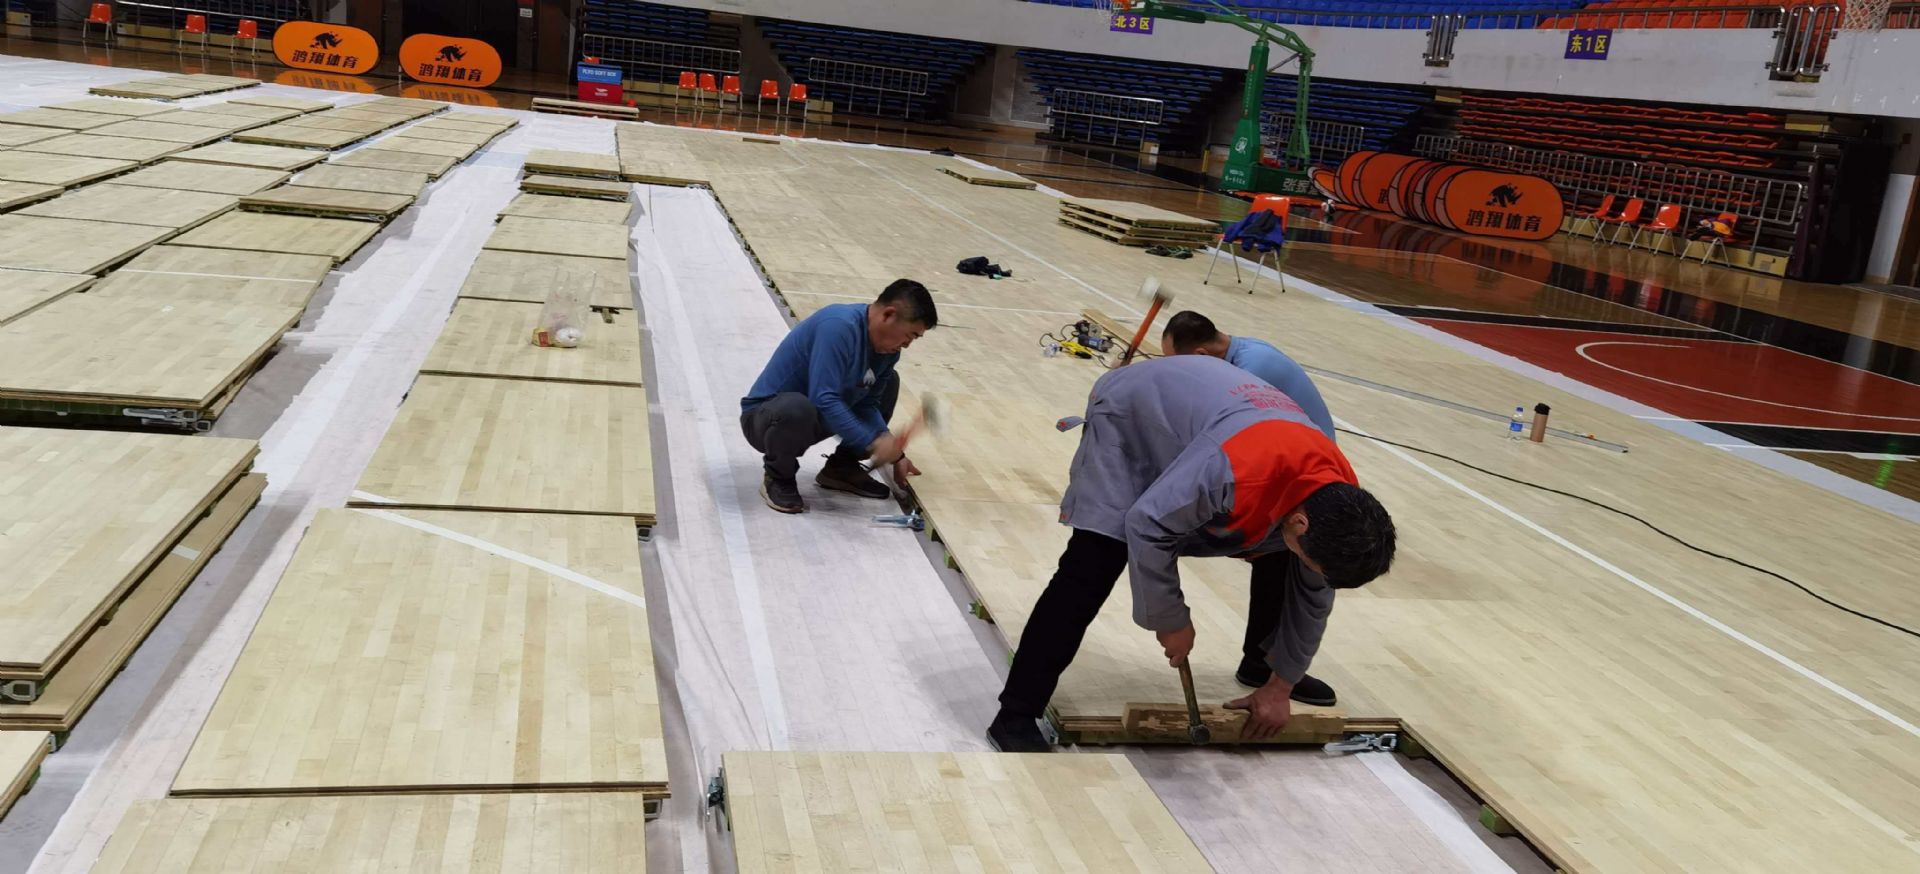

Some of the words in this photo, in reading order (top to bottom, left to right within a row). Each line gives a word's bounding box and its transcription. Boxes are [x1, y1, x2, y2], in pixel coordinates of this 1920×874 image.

[1115, 15, 1150, 30] 北3区
[1569, 34, 1608, 54] 东1区
[292, 49, 359, 69] 鸿翔体育
[419, 63, 482, 82] 鸿翔体育
[1466, 209, 1543, 232] 鸿翔体育
